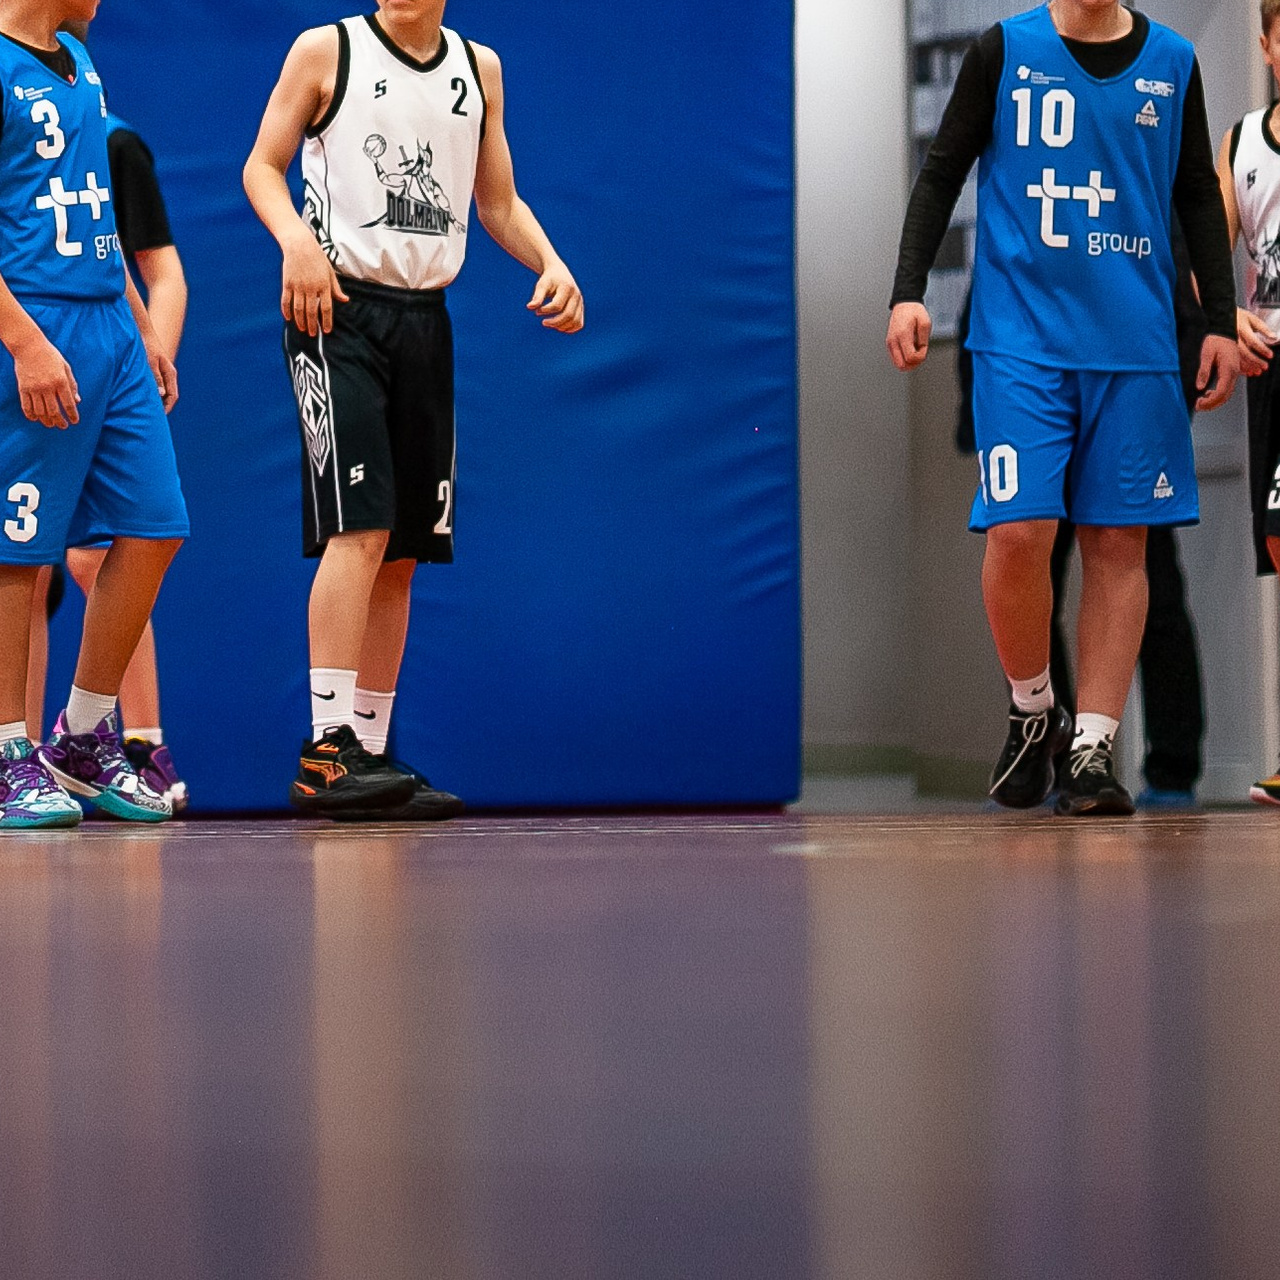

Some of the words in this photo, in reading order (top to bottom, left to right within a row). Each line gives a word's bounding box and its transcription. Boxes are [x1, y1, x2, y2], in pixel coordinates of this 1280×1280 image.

[450, 77, 468, 116] 2
[1011, 87, 1076, 148] 10
[30, 98, 66, 160] 3
[1087, 230, 1152, 259] group
[3, 481, 40, 543] 3
[433, 479, 451, 535] 2
